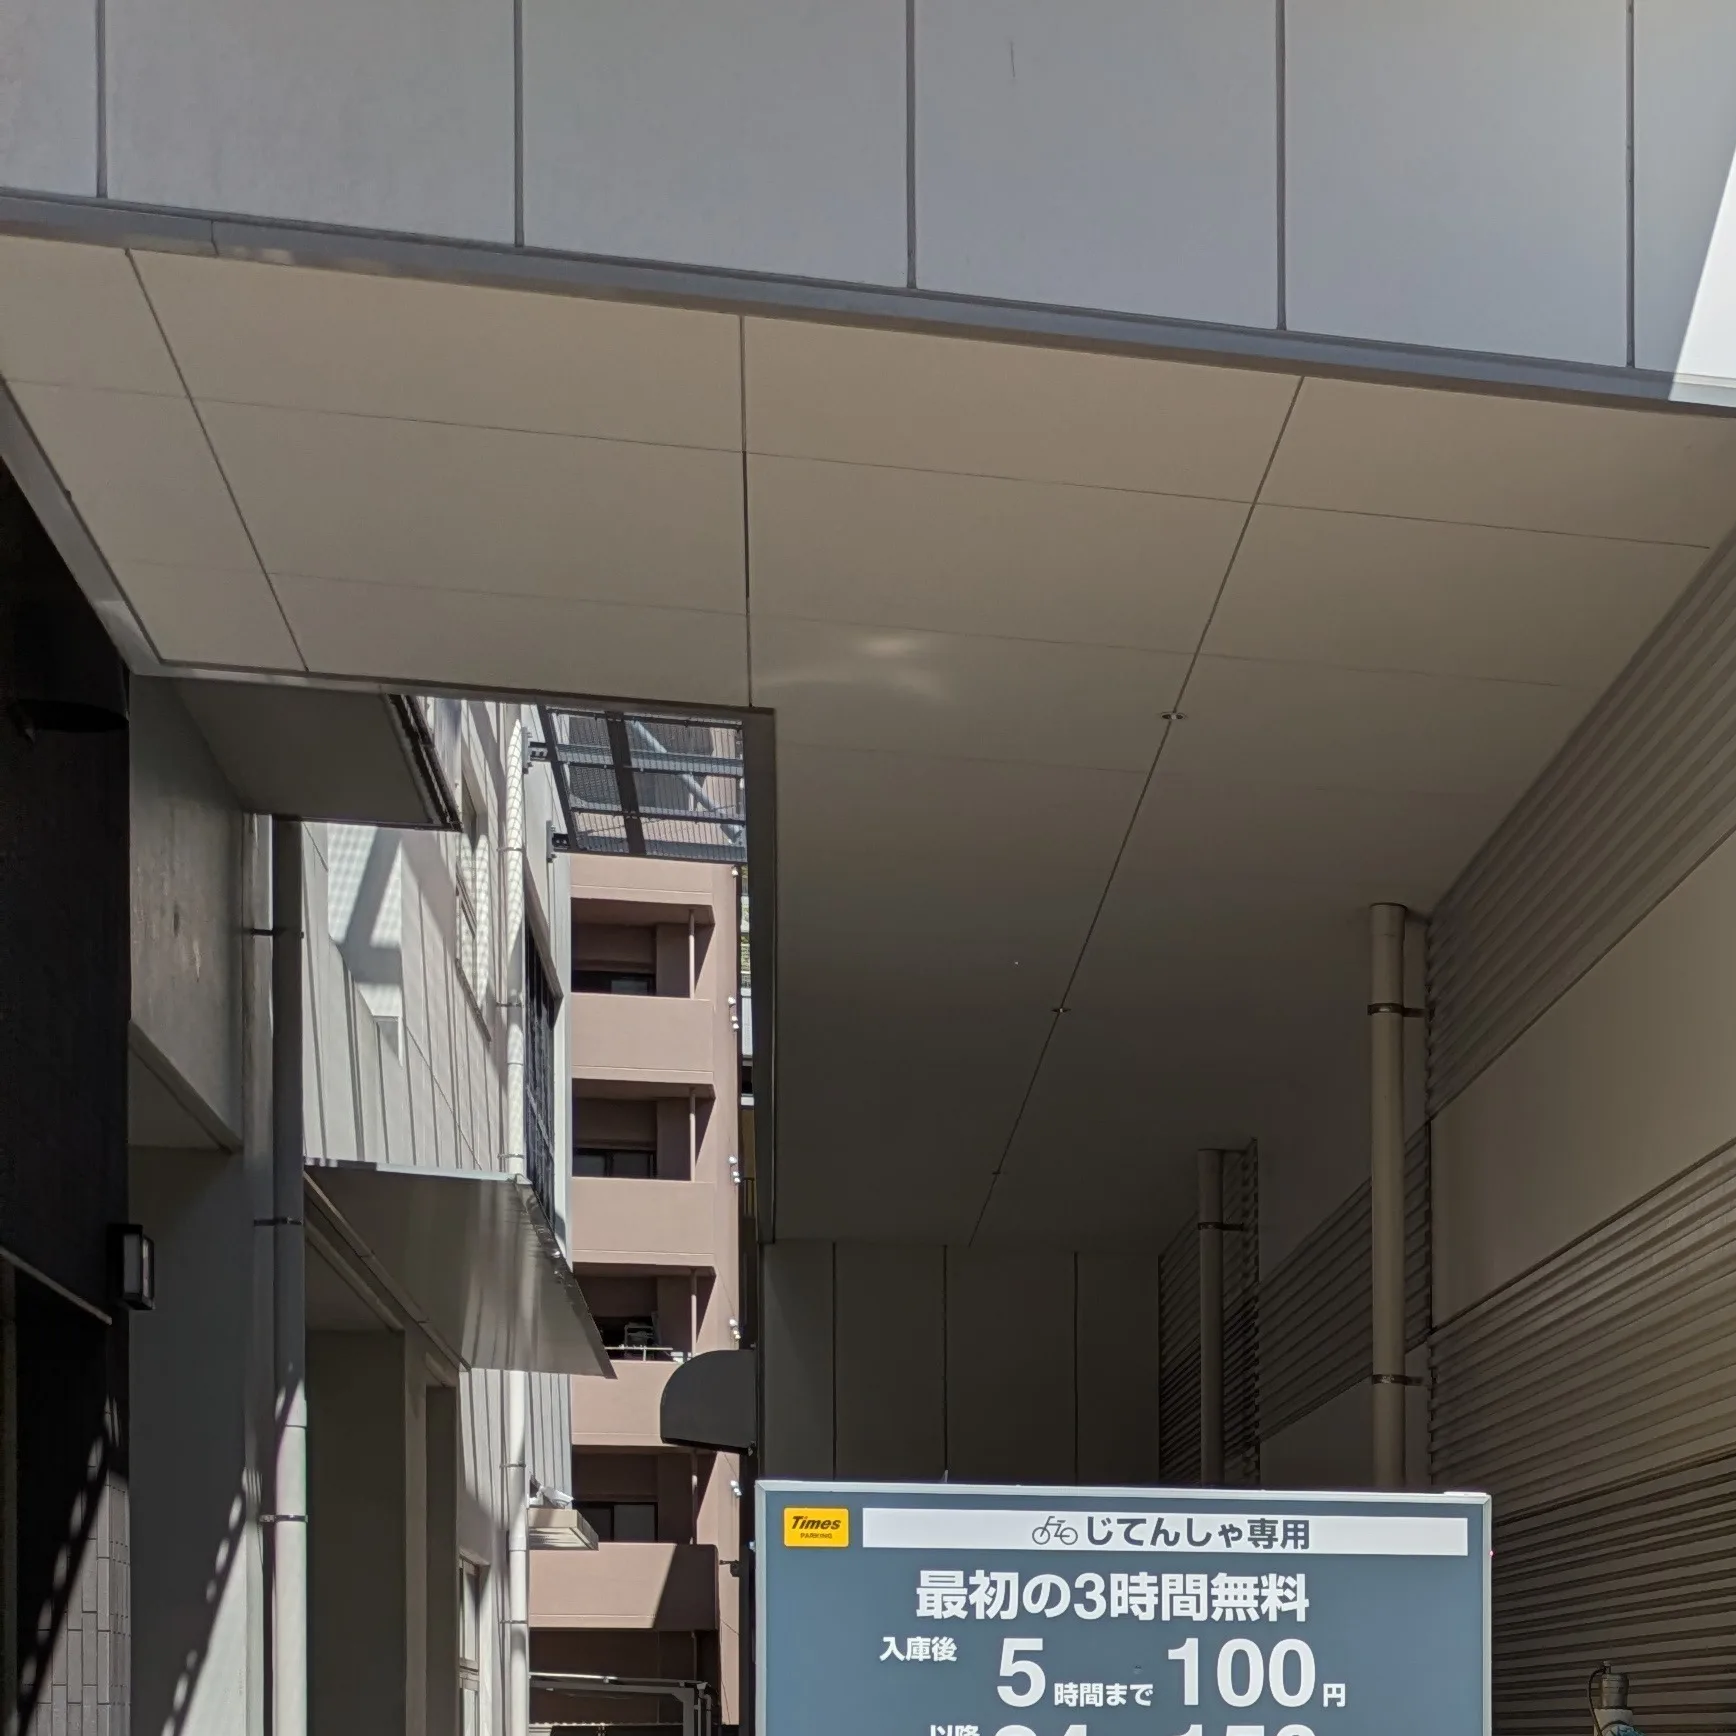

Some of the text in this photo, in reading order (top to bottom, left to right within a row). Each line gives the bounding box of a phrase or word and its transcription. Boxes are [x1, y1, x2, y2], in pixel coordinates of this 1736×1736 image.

[791, 1515, 842, 1530] Times
[1086, 1516, 1311, 1550] じてんしゃ専用
[915, 1570, 1310, 1622] 最初の3時間無料
[879, 1636, 957, 1663] 入庫後
